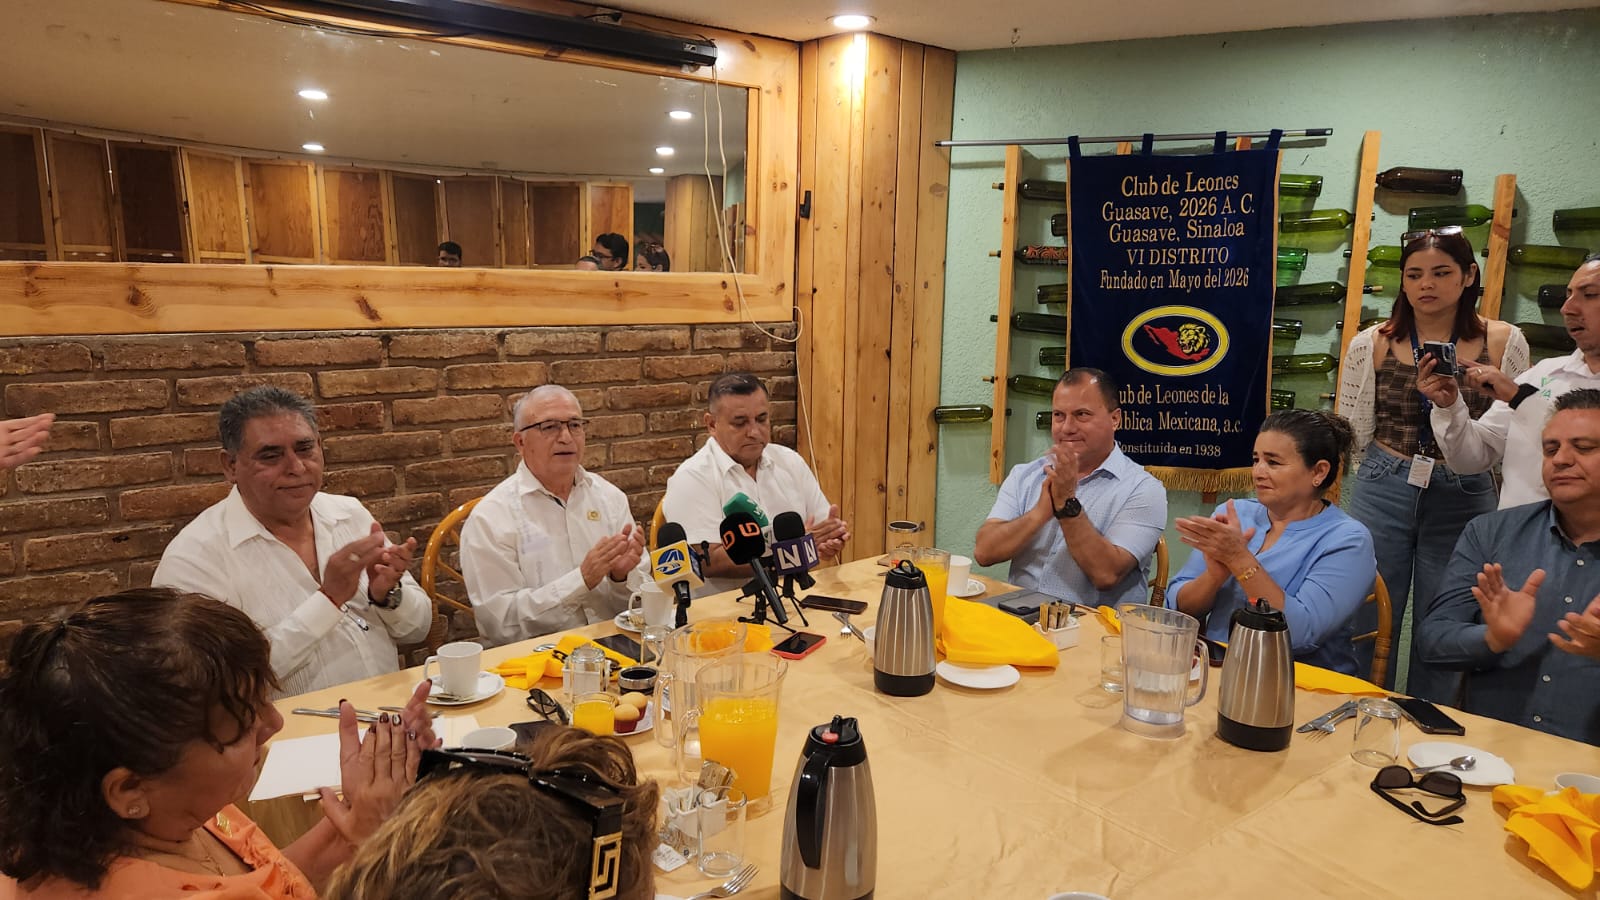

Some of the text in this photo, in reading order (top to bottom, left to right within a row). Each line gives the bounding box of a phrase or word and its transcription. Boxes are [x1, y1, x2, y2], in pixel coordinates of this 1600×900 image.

[1121, 171, 1239, 197] Club de Leones
[1102, 201, 1173, 223] Guasave,
[1179, 196, 1217, 217] 2026
[1186, 217, 1245, 239] Sinaloa
[1127, 246, 1229, 265] VI DISTRITO
[1100, 267, 1250, 293] Fundado en Mayo del 2026
[1119, 384, 1229, 406] ub de Leones de la
[1158, 410, 1221, 436] Mexicana,
[1179, 445, 1193, 455] en
[1194, 443, 1222, 457] 1938
